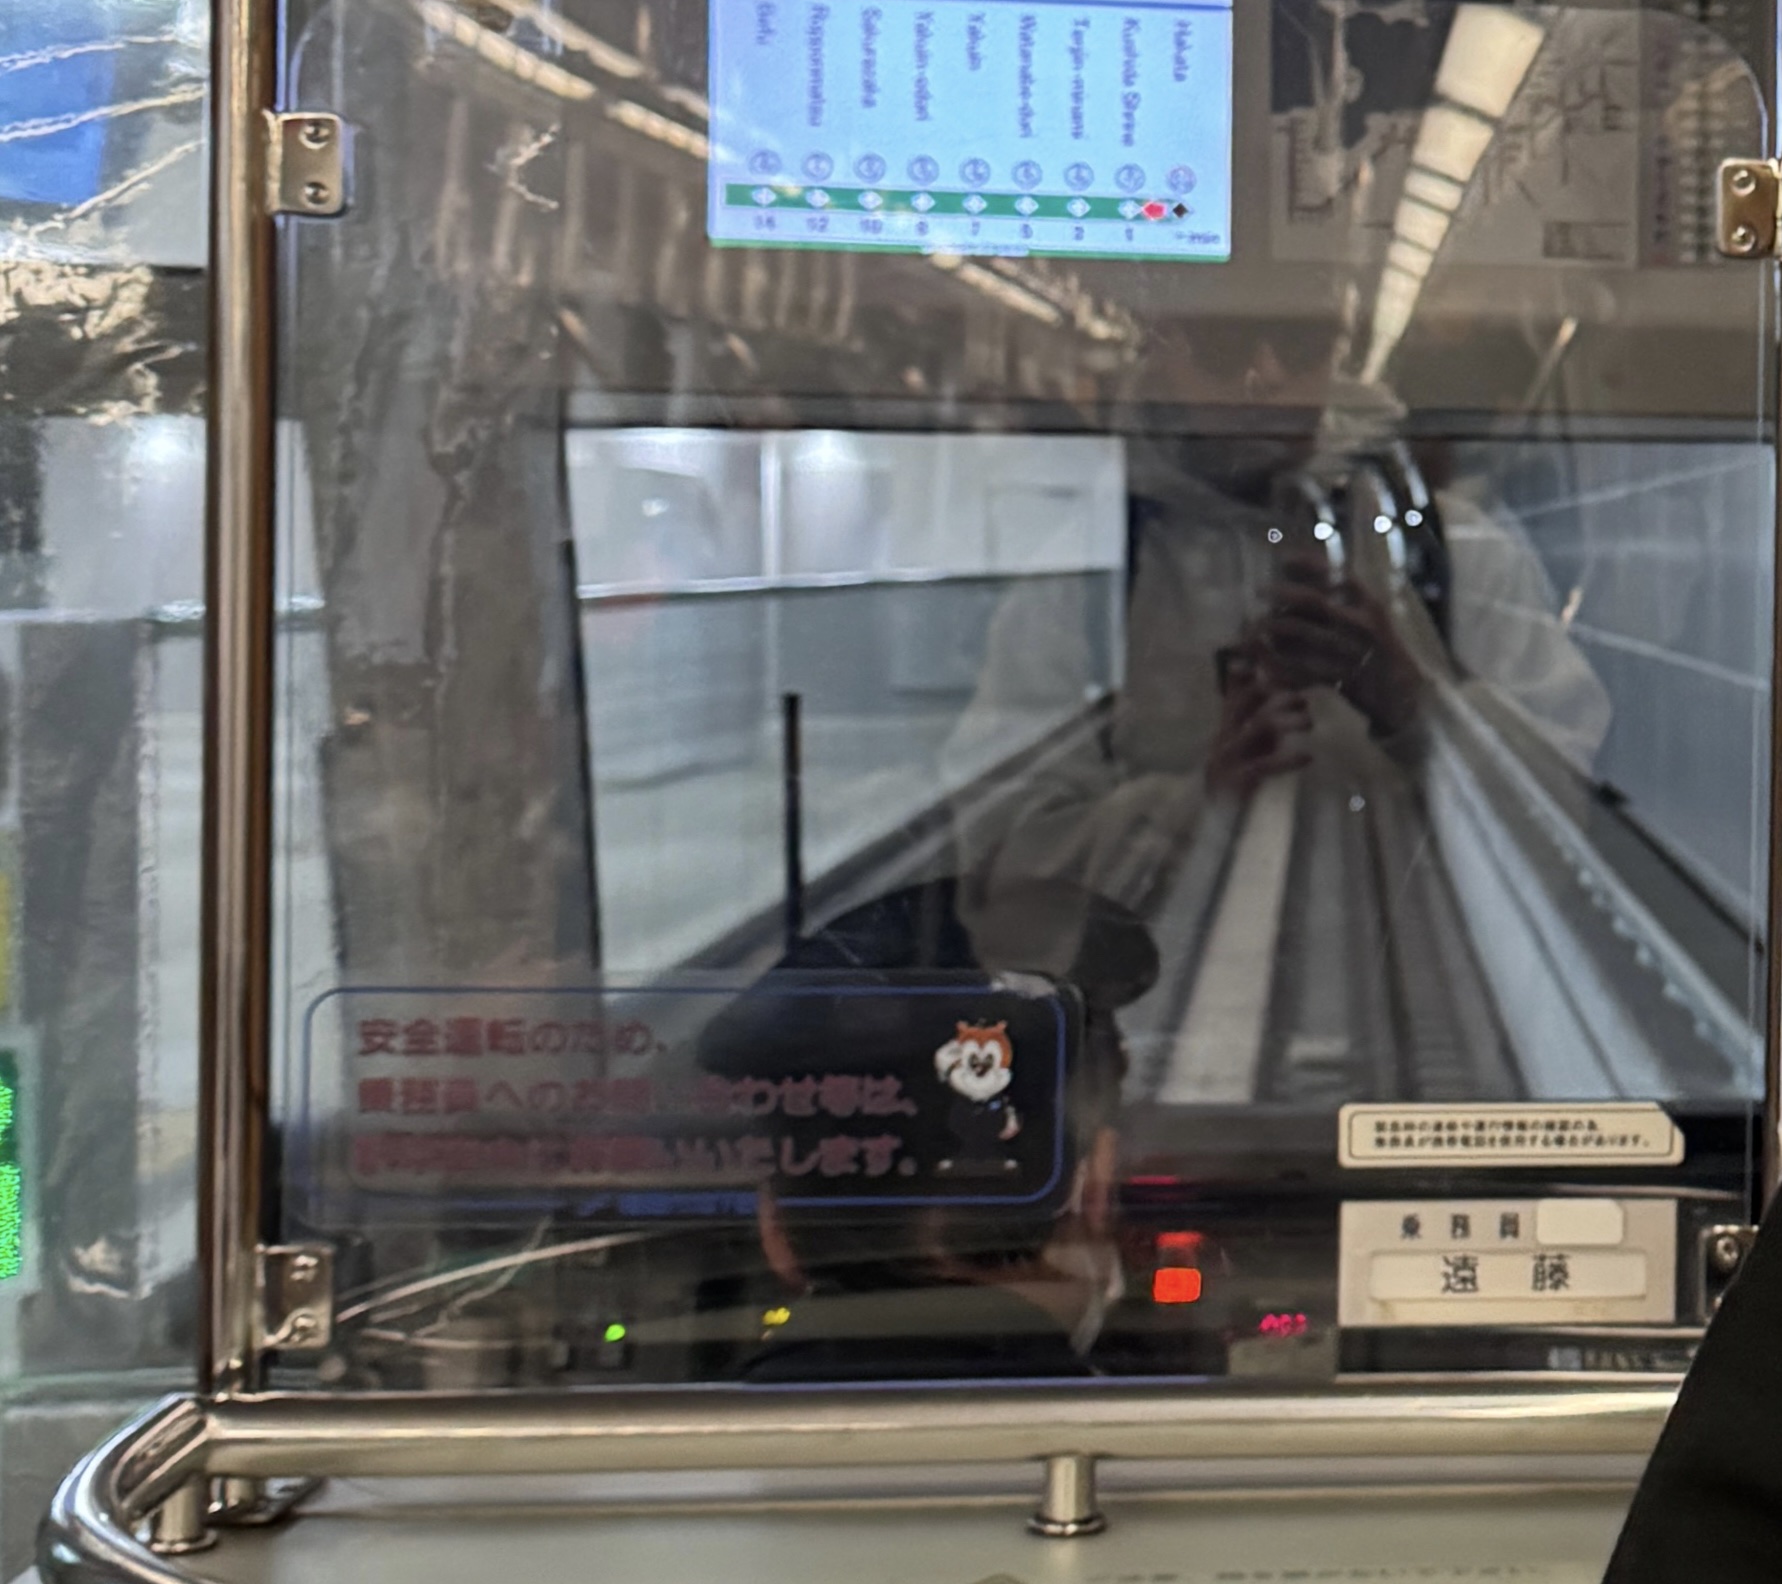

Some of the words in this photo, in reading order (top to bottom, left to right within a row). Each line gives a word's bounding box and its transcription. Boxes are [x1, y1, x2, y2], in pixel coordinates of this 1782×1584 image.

[358, 1018, 668, 1055] 安全運転のため、
[358, 1074, 918, 1117] 乗務員へのお問合わせ等は、
[1401, 1212, 1520, 1240] 乗務員
[1441, 1253, 1572, 1294] 遠藤
